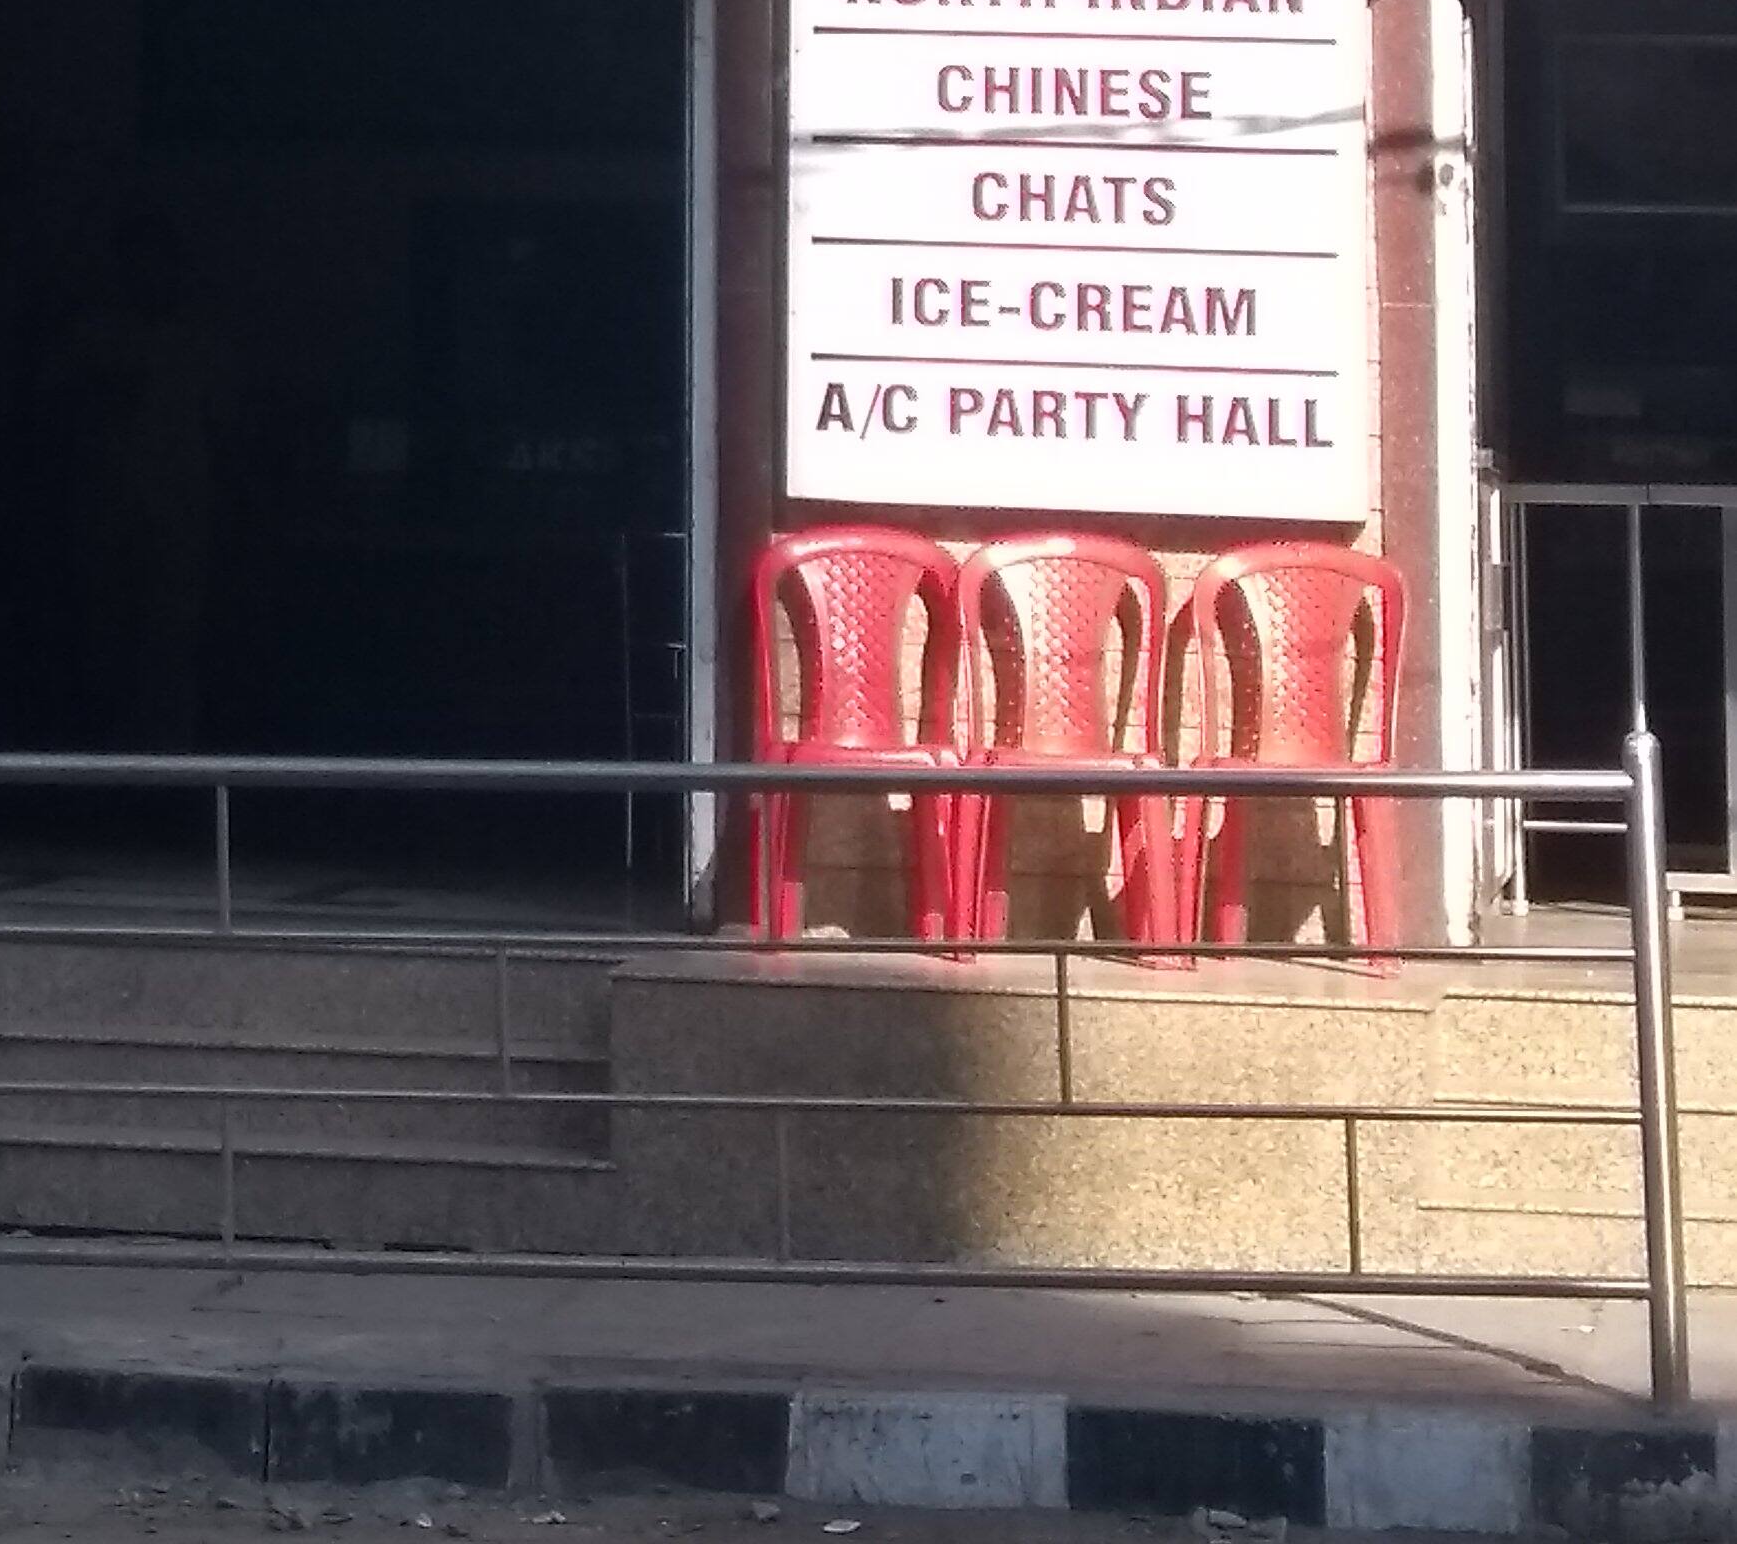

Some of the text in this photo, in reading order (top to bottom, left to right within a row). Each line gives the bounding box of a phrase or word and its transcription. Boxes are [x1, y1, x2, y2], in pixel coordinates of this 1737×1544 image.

[936, 64, 1213, 120] CHINESE
[971, 171, 1177, 225] CHATS
[890, 277, 1257, 337] ICE-CREAM
[815, 382, 1334, 448] A/C PARTY HALL
